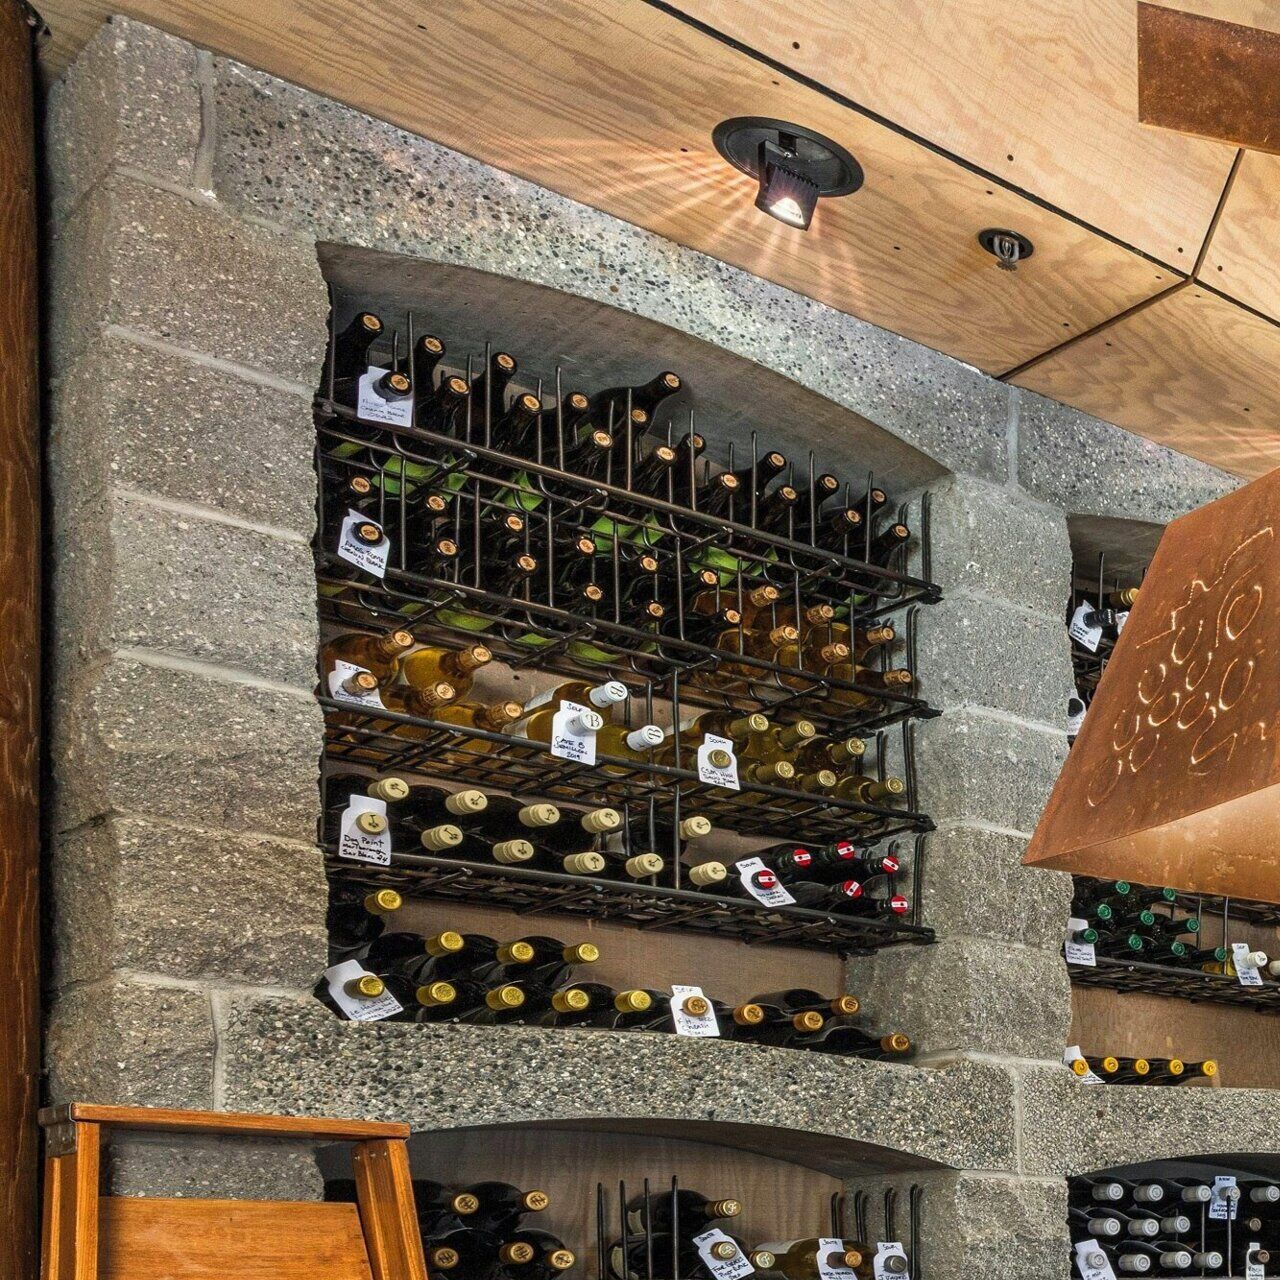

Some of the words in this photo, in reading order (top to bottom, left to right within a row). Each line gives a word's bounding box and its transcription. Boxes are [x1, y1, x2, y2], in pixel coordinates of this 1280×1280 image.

[344, 834, 359, 846] Dog
[361, 836, 385, 846] Point
[377, 853, 388, 863] 24
